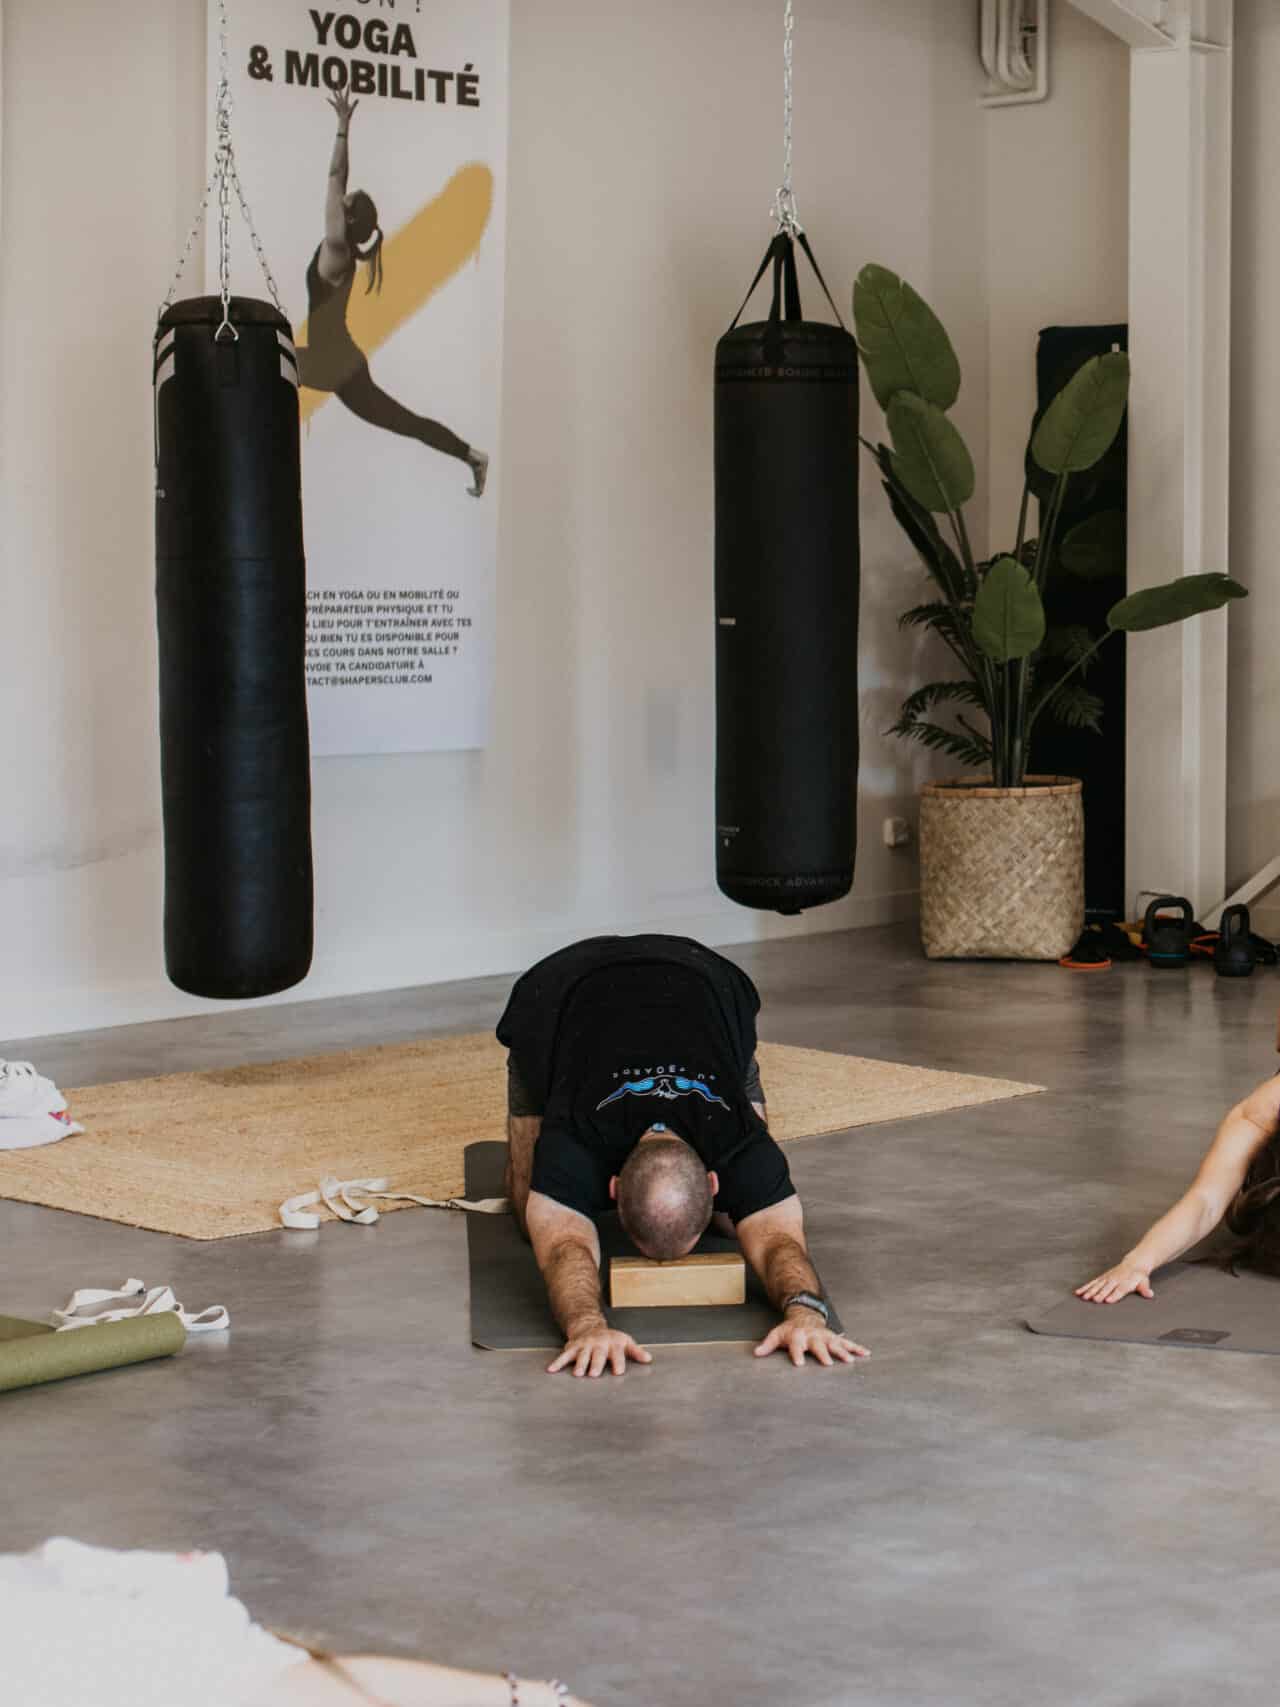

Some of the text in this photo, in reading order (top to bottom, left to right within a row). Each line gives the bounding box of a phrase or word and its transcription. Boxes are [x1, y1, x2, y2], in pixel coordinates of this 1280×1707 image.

[309, 9, 417, 58] YOGA
[247, 45, 481, 107] & MOBILITÉ
[323, 591, 336, 600] EN
[339, 590, 364, 600] YOGA
[367, 590, 381, 600] OU
[383, 590, 397, 600] EN
[399, 588, 444, 600] MOBILITÉ
[447, 590, 460, 599] OU
[376, 604, 424, 616] PHYSIQUE
[427, 604, 439, 613] ET
[442, 604, 453, 613] TU
[313, 619, 334, 629] LIEU
[337, 618, 362, 628] POUR
[431, 618, 454, 627] AVEC
[457, 618, 473, 627] TES
[320, 633, 343, 642] BIEN
[346, 632, 358, 642] TU
[361, 632, 373, 642] ES
[376, 631, 432, 642] DISPONIBLE
[435, 631, 459, 641] POUR
[323, 647, 355, 657] COURS
[358, 647, 385, 657] DANS
[387, 646, 418, 656] NOTRE
[422, 646, 450, 655] SALLE
[335, 662, 346, 671] TA
[348, 661, 415, 671] CANDIDATURE
[418, 658, 425, 669] À
